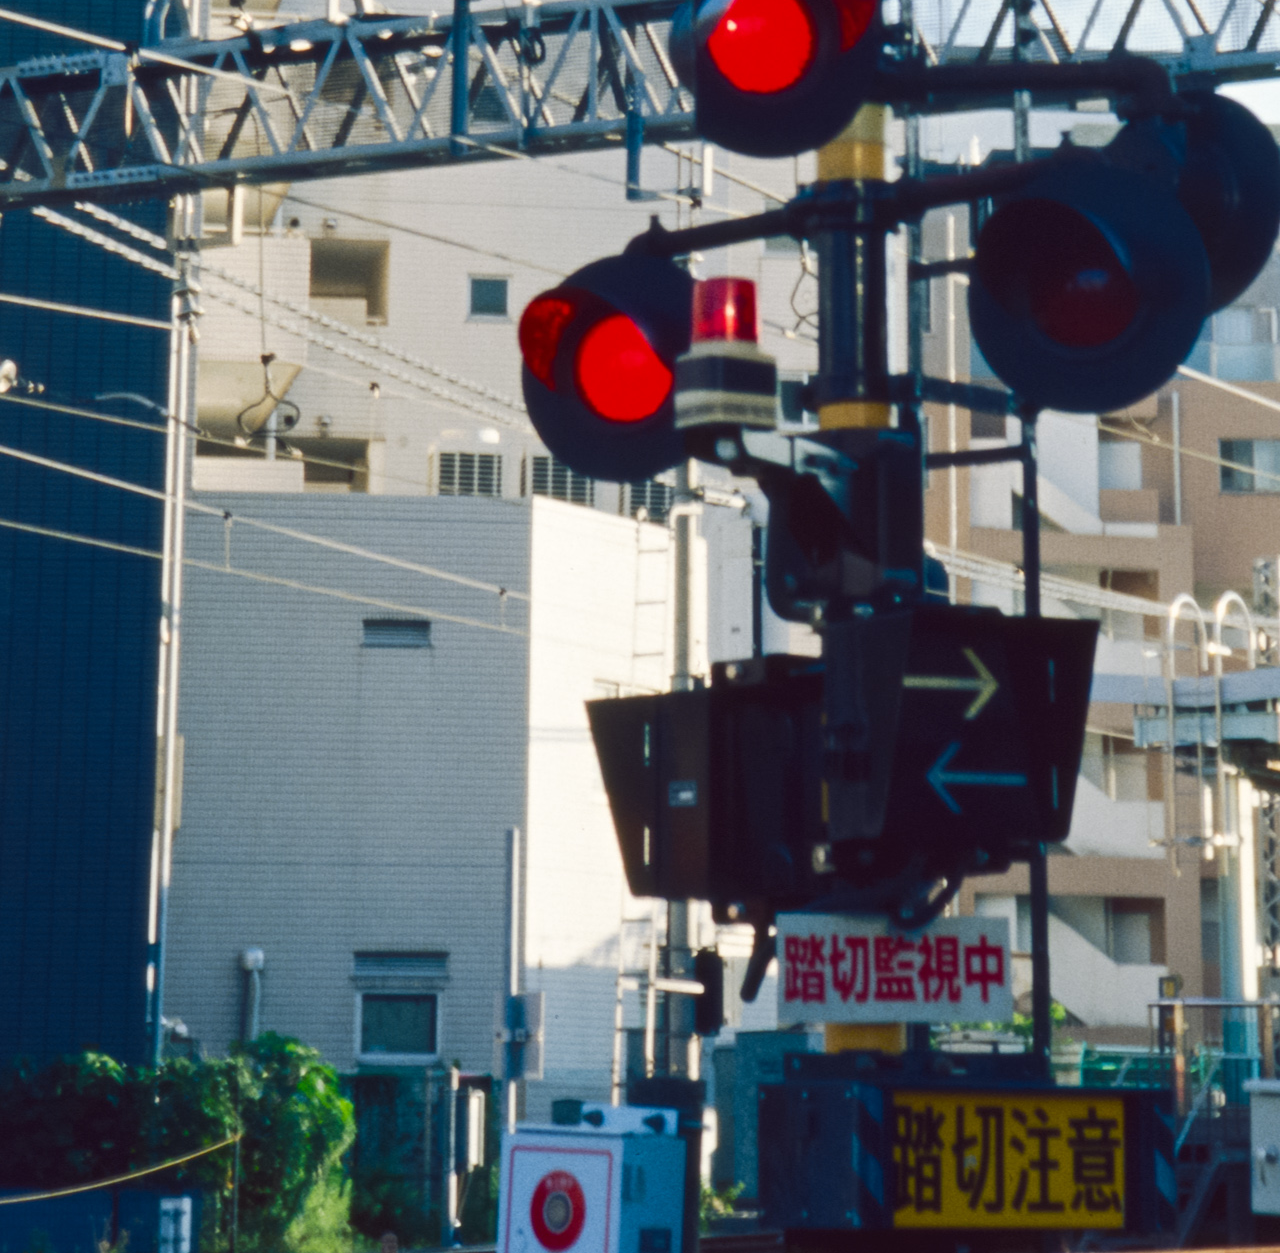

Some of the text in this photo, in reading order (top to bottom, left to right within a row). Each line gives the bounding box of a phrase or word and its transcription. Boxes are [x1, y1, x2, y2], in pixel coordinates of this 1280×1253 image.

[784, 935, 1005, 1004] 踏切監視中
[893, 1105, 1123, 1214] 踏切注意
